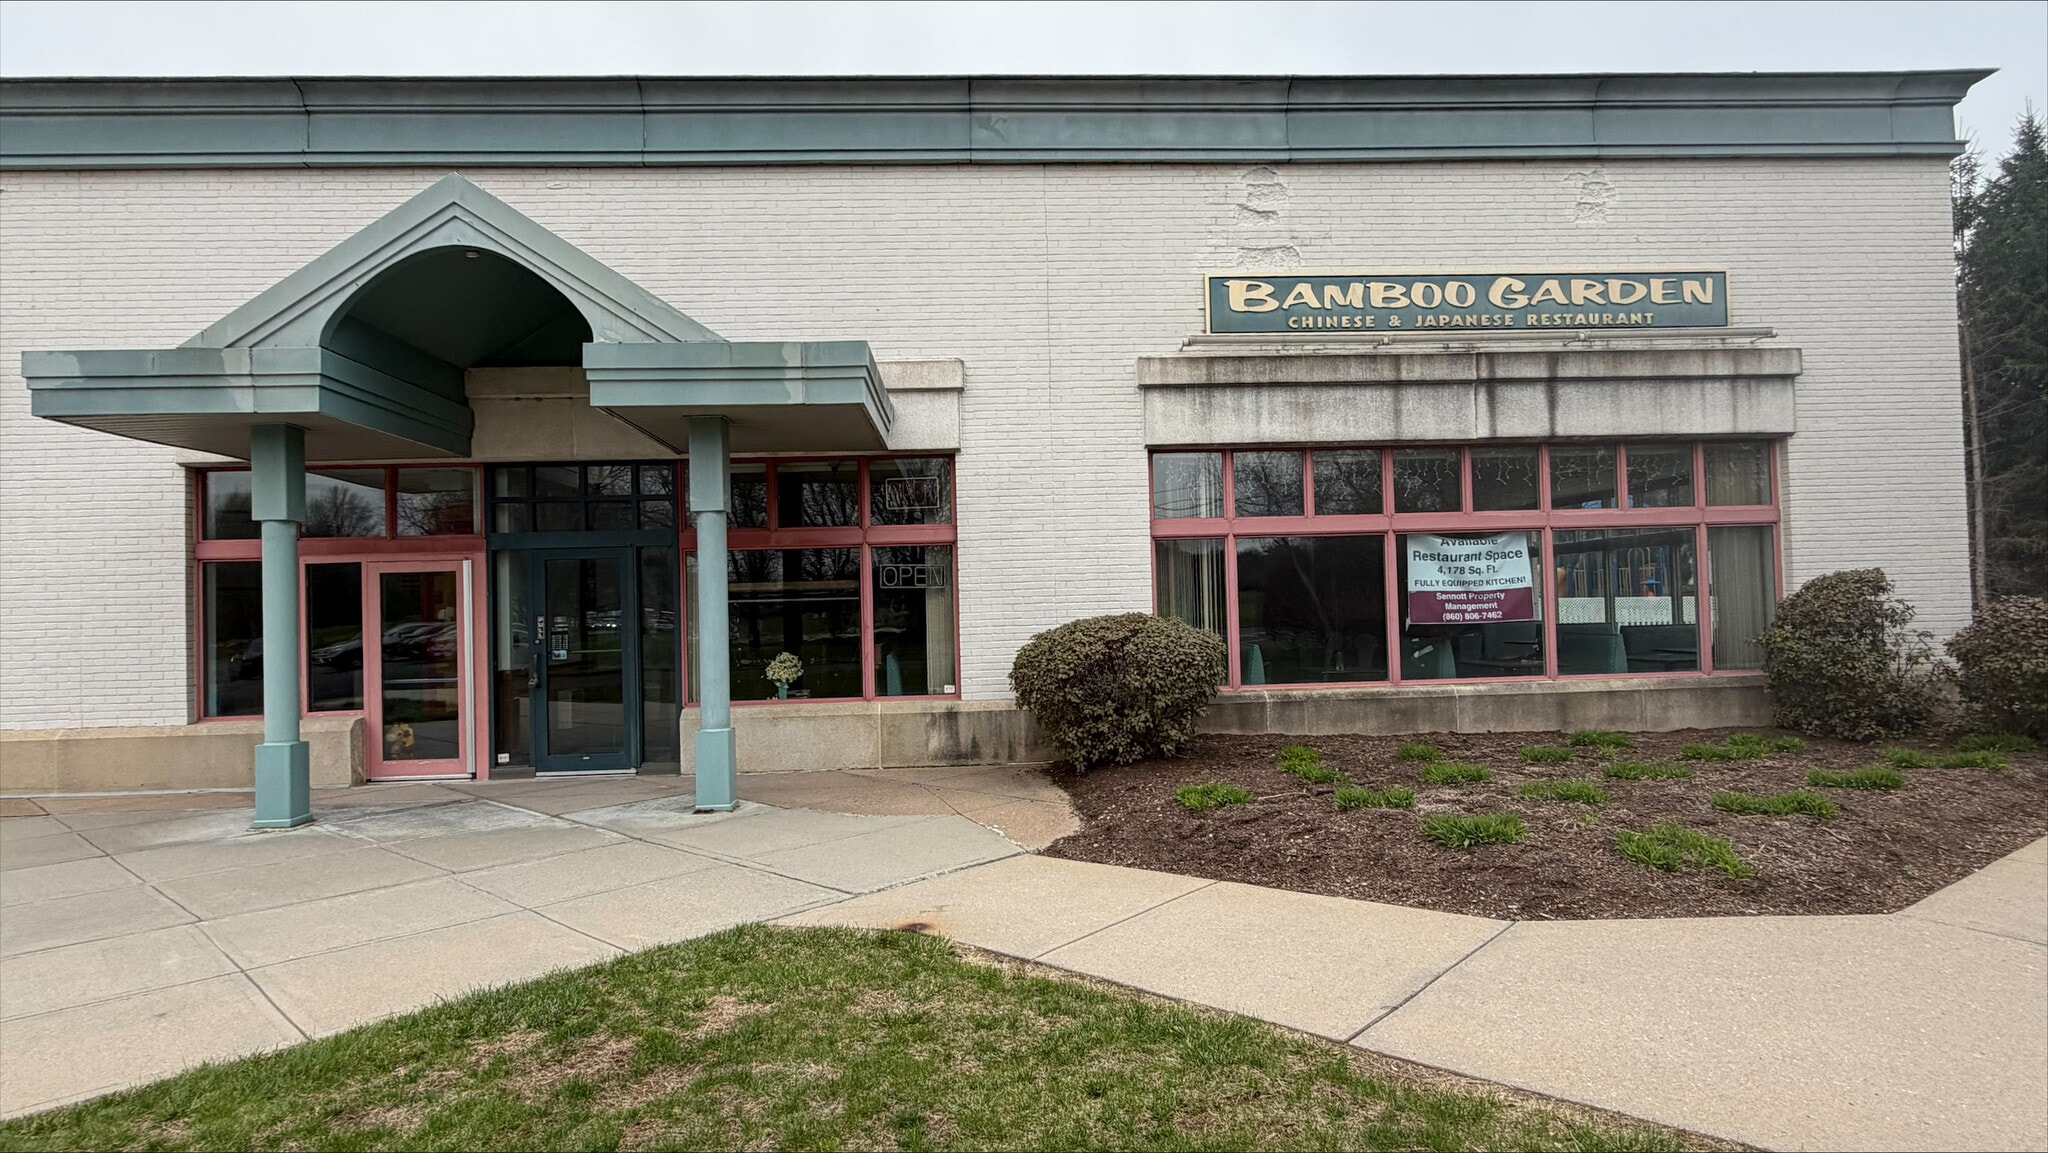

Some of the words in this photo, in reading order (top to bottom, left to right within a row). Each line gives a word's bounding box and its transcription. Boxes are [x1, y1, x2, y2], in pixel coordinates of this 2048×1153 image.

[1223, 280, 1476, 312] BAMBOO
[1488, 277, 1714, 309] GARDEN
[1288, 315, 1376, 328] CHINESE
[1388, 315, 1402, 327] &
[1415, 313, 1515, 327] JAPANESE
[1527, 312, 1655, 326] RESTAURANT
[1413, 551, 1482, 562] Restaurant
[1485, 549, 1523, 561] Space
[883, 566, 944, 586] OPEN
[1437, 566, 1466, 575] 4,178
[1468, 566, 1485, 576] Sq.
[1486, 565, 1499, 573] Ft.
[1414, 579, 1440, 587] FULLY
[1442, 579, 1484, 587] EQUIPPED
[1485, 576, 1527, 586] KITCHEN!
[1436, 592, 1467, 600] Sennott
[1468, 592, 1505, 601] Property
[1444, 602, 1498, 611] Management
